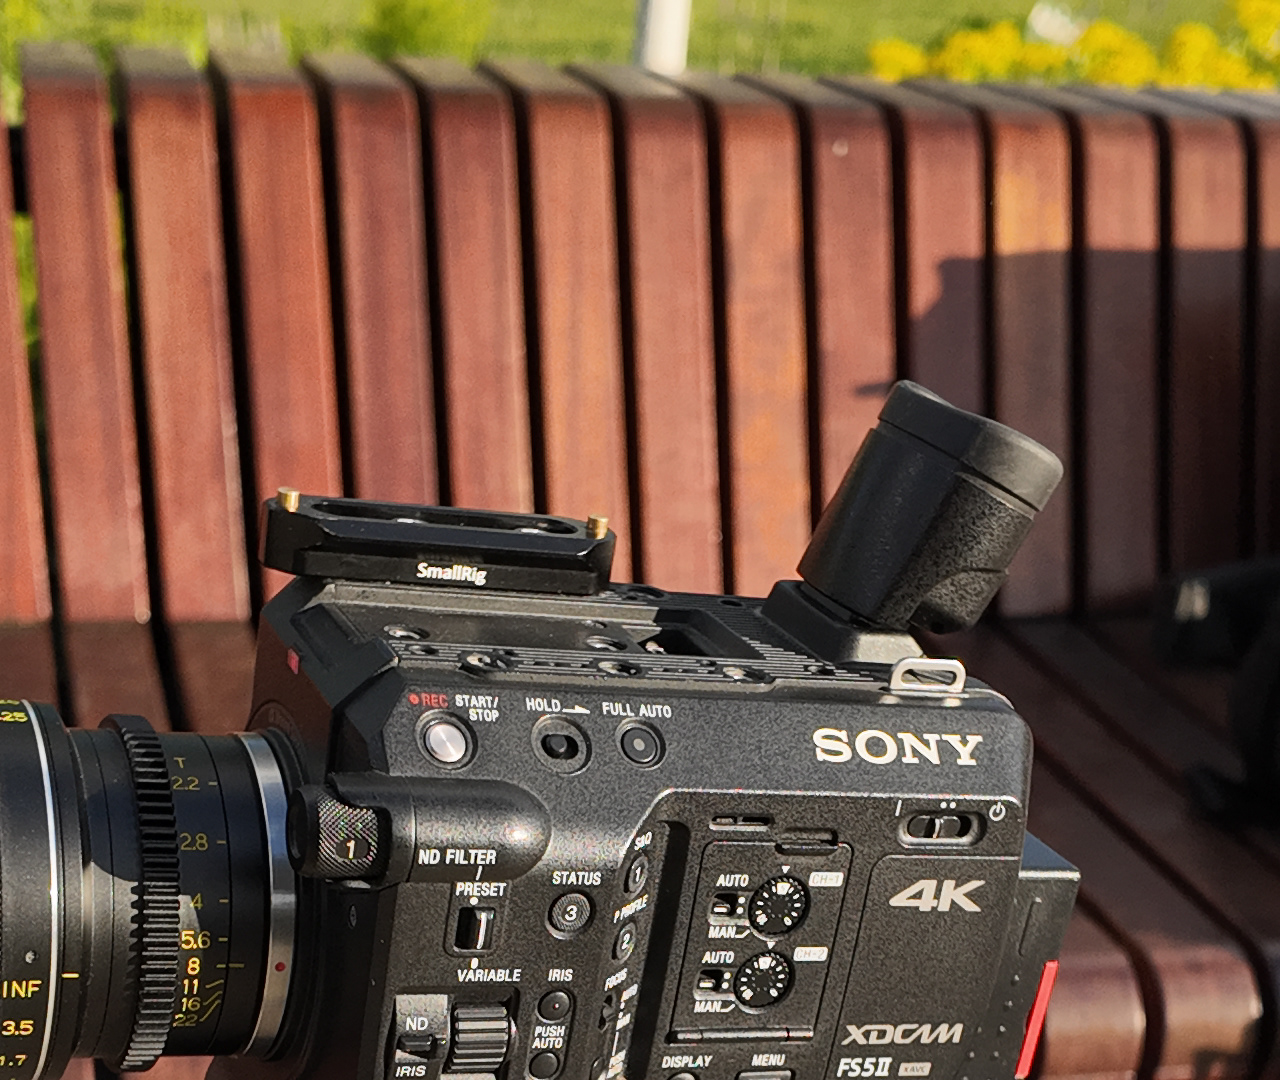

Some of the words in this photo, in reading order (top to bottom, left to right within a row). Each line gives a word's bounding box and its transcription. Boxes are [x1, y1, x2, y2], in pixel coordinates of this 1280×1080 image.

[417, 562, 487, 586] SmallRig
[421, 693, 449, 707] REC
[455, 694, 499, 708] START/
[525, 697, 561, 712] HOLD
[469, 708, 500, 722] STOP
[602, 702, 634, 717] FULL
[639, 704, 672, 719] AUTO
[812, 727, 984, 766] SONY
[173, 756, 187, 769] T
[171, 775, 200, 791] 2.2
[180, 832, 209, 851] 2.8
[345, 839, 356, 860] 1
[418, 849, 441, 865] ND
[445, 849, 497, 865] FILTER
[552, 871, 602, 886] STATUS
[716, 873, 749, 887] AUTO
[455, 882, 507, 897] PRESET
[888, 879, 985, 913] 4K
[190, 892, 204, 910] 4
[564, 904, 578, 921] 3
[180, 930, 211, 949] 5.6
[708, 926, 737, 939] MAN
[701, 951, 735, 964] AUTO
[187, 957, 200, 975] 8
[457, 969, 521, 982] VARIABLE
[548, 969, 573, 982] IRIS
[3, 980, 42, 998] INF
[183, 978, 199, 995] 11
[181, 996, 201, 1012] 16
[694, 1001, 722, 1013] MAN
[173, 1013, 198, 1027] 22
[405, 1017, 428, 1031] ND
[1, 1020, 34, 1036] 3.5
[534, 1025, 565, 1038] PUSH
[841, 1023, 964, 1045] XDCAM
[531, 1037, 563, 1049] AUTO
[661, 1055, 713, 1069] DISPLAY
[752, 1053, 785, 1066] MENU
[395, 1065, 427, 1078] IRIS
